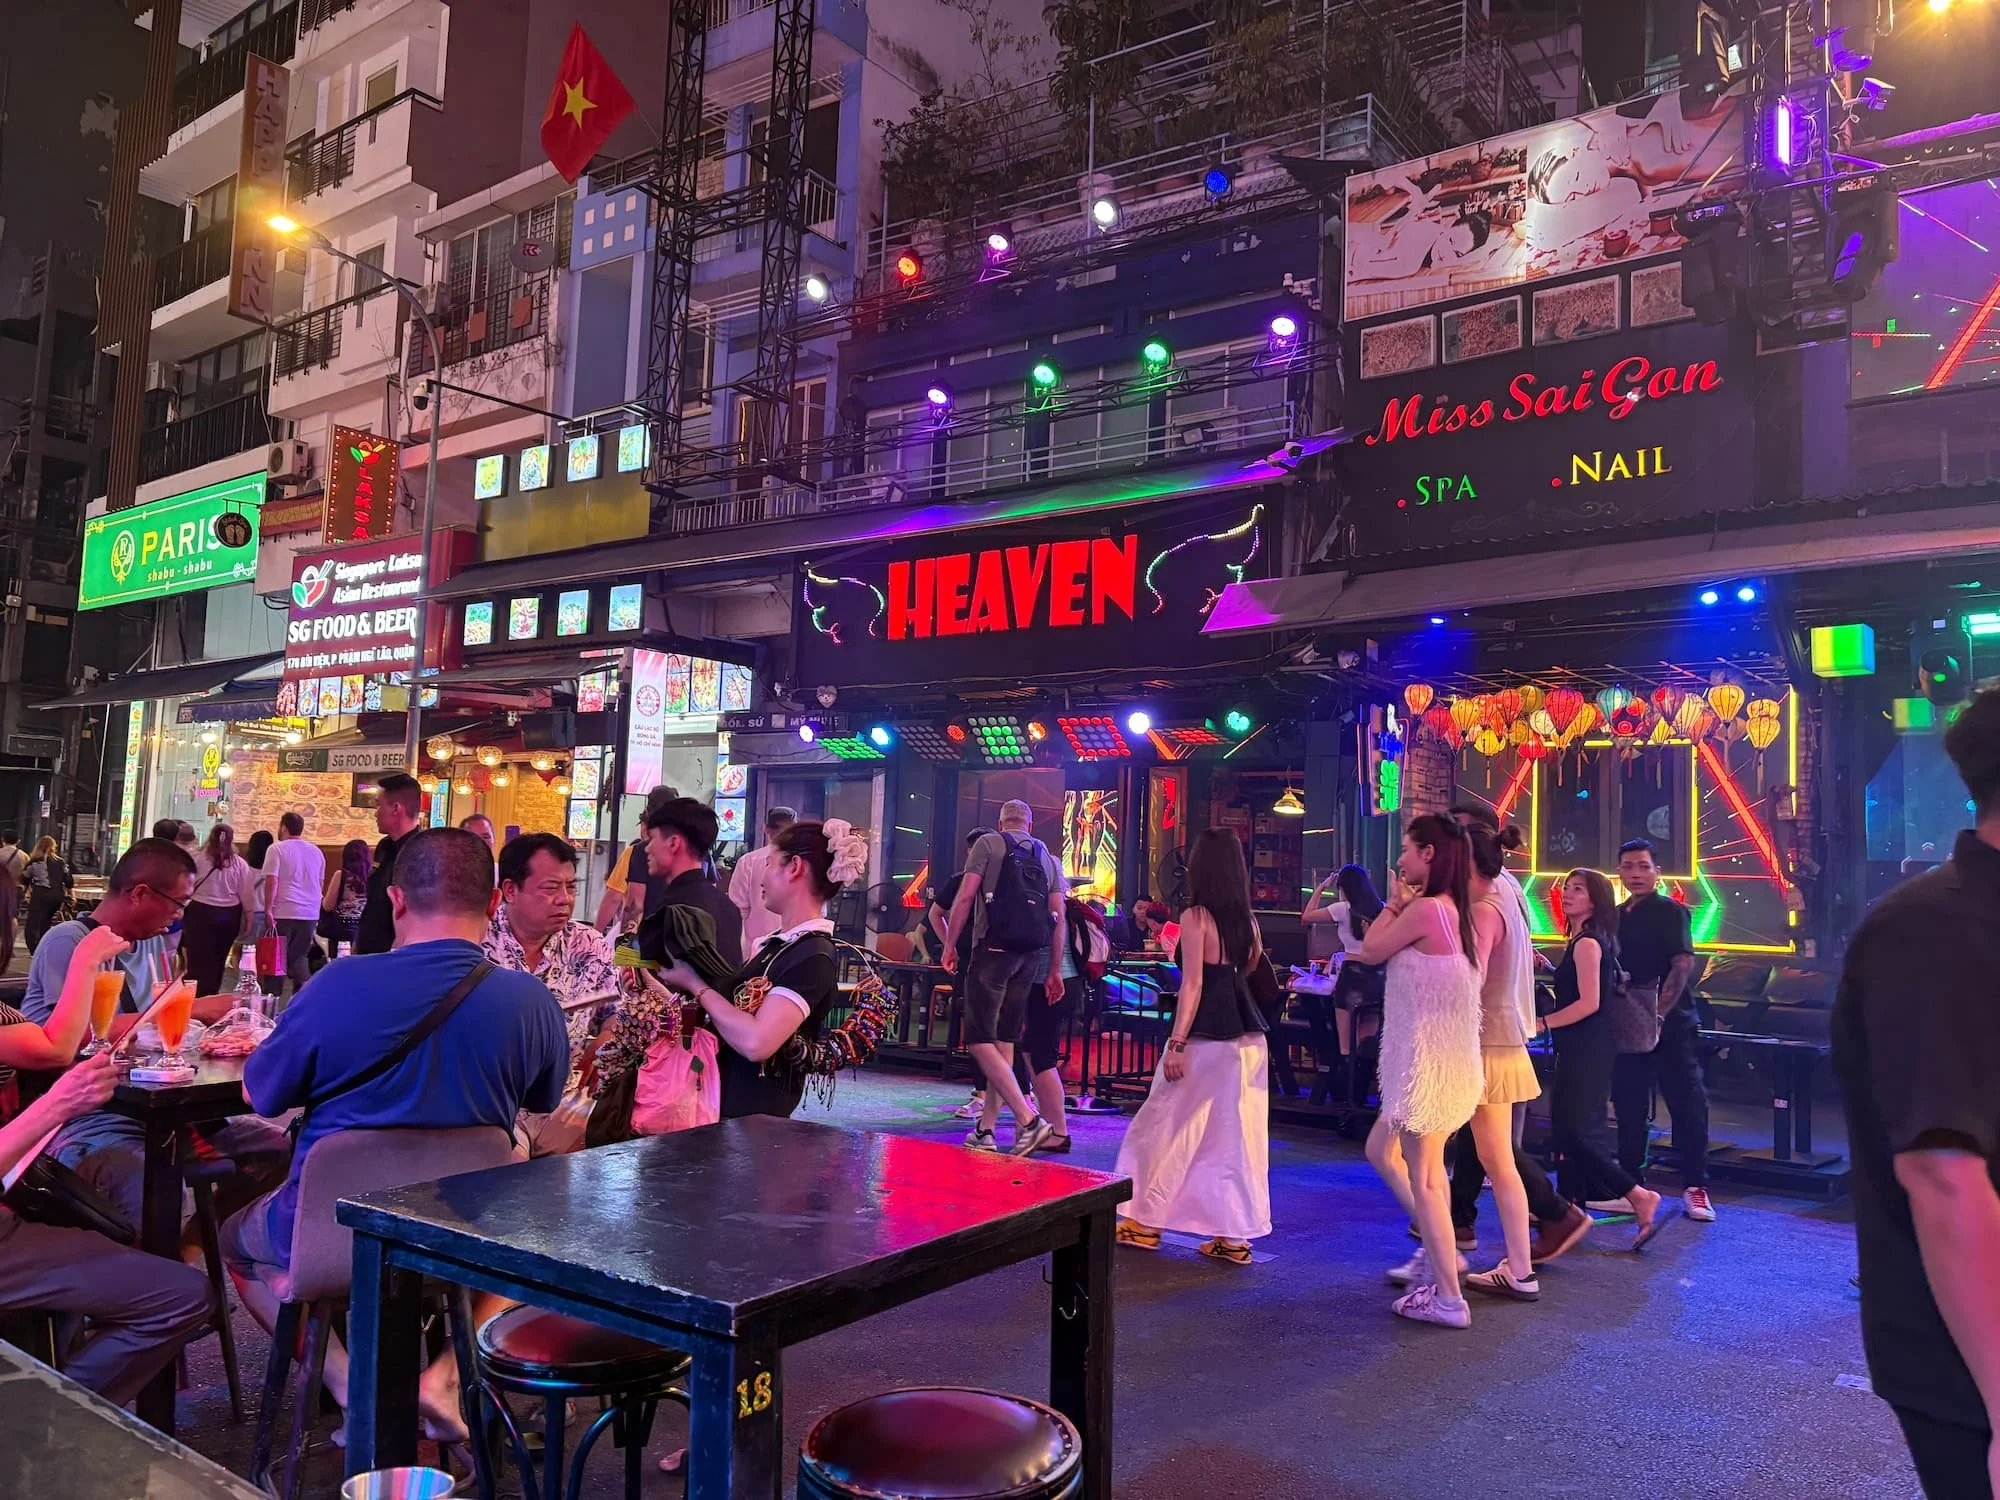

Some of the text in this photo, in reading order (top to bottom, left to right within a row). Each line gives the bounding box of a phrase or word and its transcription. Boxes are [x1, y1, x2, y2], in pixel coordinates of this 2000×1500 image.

[1365, 394, 1493, 445] Miss
[1415, 446, 1673, 507] SPA NAIL
[352, 466, 374, 540] LAKSA
[141, 514, 221, 565] PARIS
[147, 565, 176, 582] shabu
[183, 558, 213, 576] shabu
[332, 576, 421, 604] Asian Restaurant
[335, 553, 423, 582] Singapore Laksa
[887, 534, 1138, 640] HEAVEN
[288, 607, 418, 643] SG FOOD & BEER
[332, 754, 344, 767] SG
[345, 754, 372, 767] FOOD
[381, 753, 405, 766] BEER
[736, 1371, 772, 1419] 18
